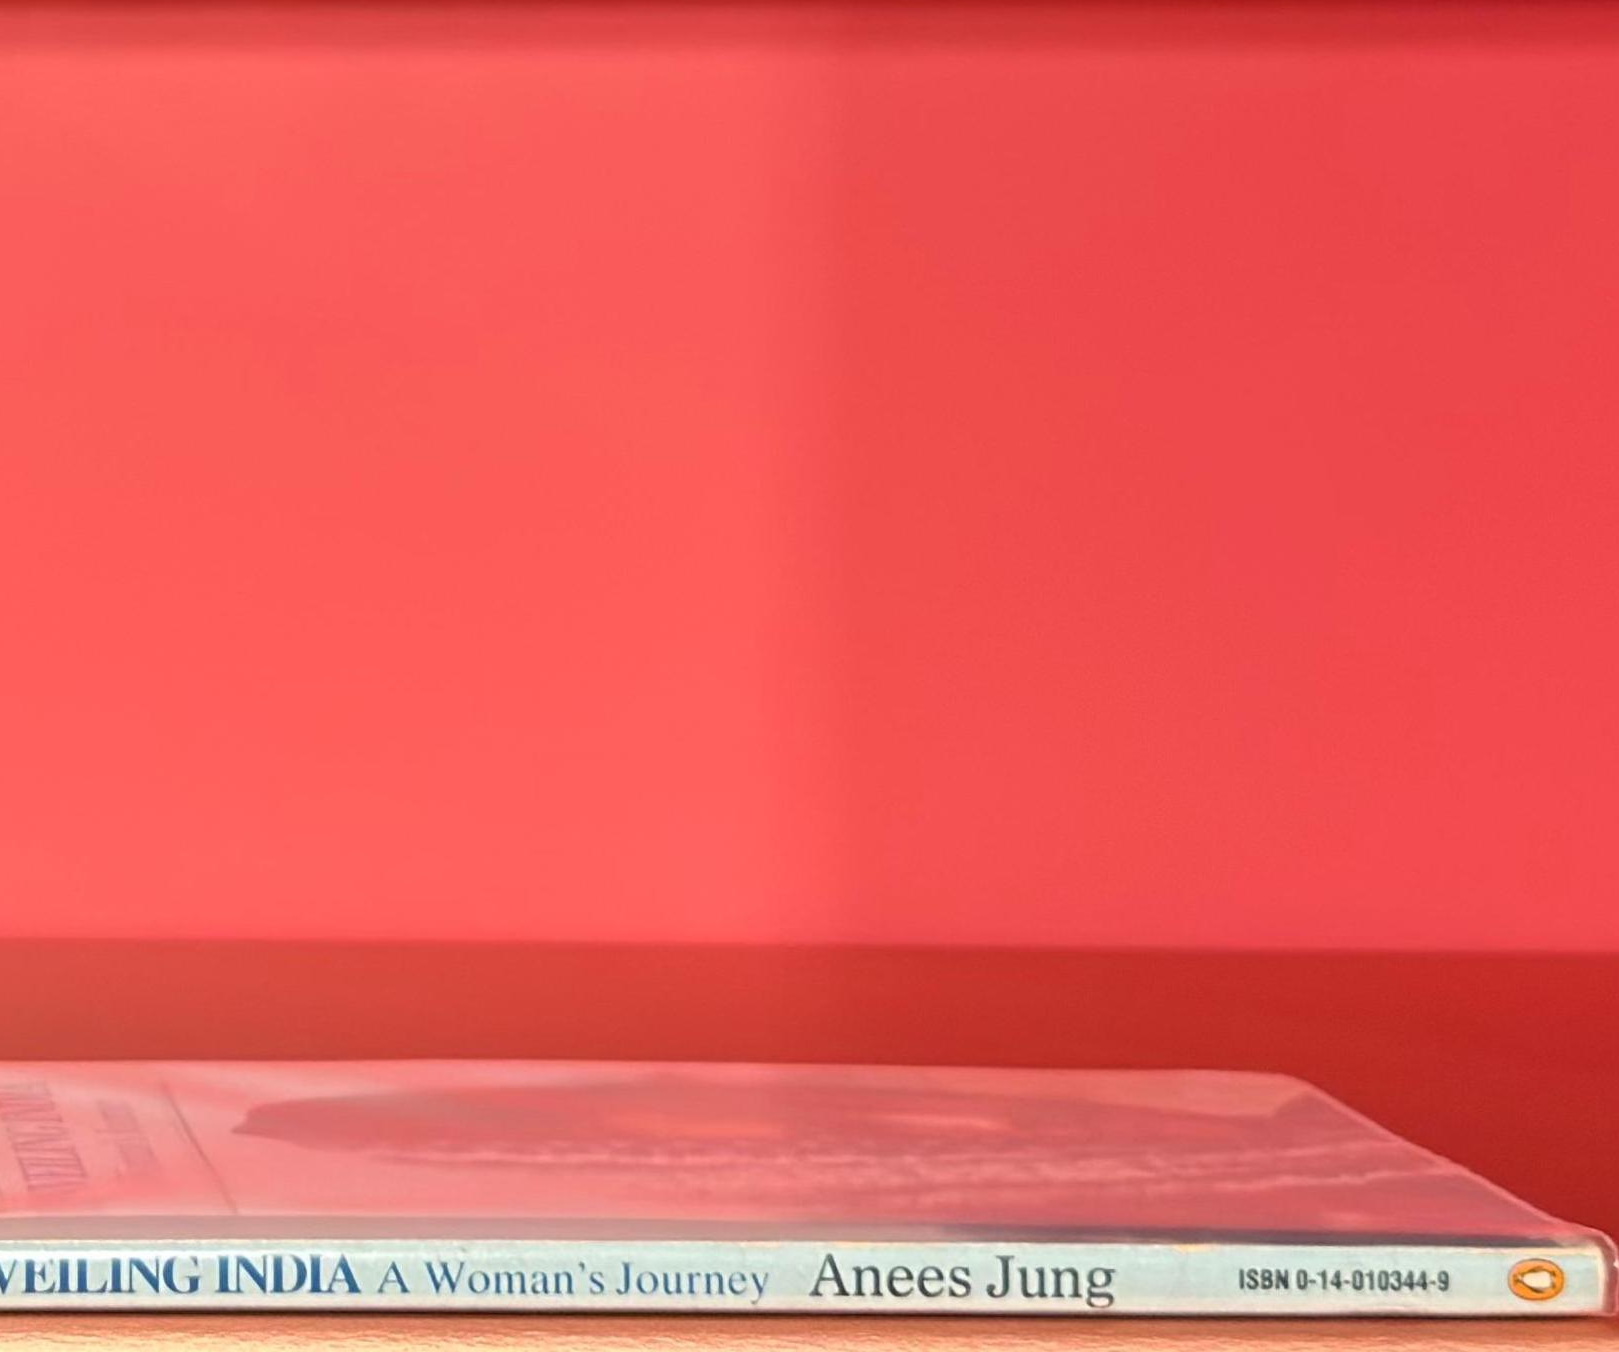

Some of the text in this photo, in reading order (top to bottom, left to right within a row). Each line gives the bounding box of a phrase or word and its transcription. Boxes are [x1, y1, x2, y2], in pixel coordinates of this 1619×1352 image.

[213, 1253, 362, 1294] INDIA
[376, 1261, 411, 1294] A
[423, 1260, 606, 1296] Woman's
[615, 1261, 769, 1305] Journey
[808, 1252, 972, 1298] Anees
[985, 1254, 1116, 1309] Jung
[1238, 1267, 1289, 1291] ISBN
[1295, 1268, 1450, 1292] 0-14-010344-9
